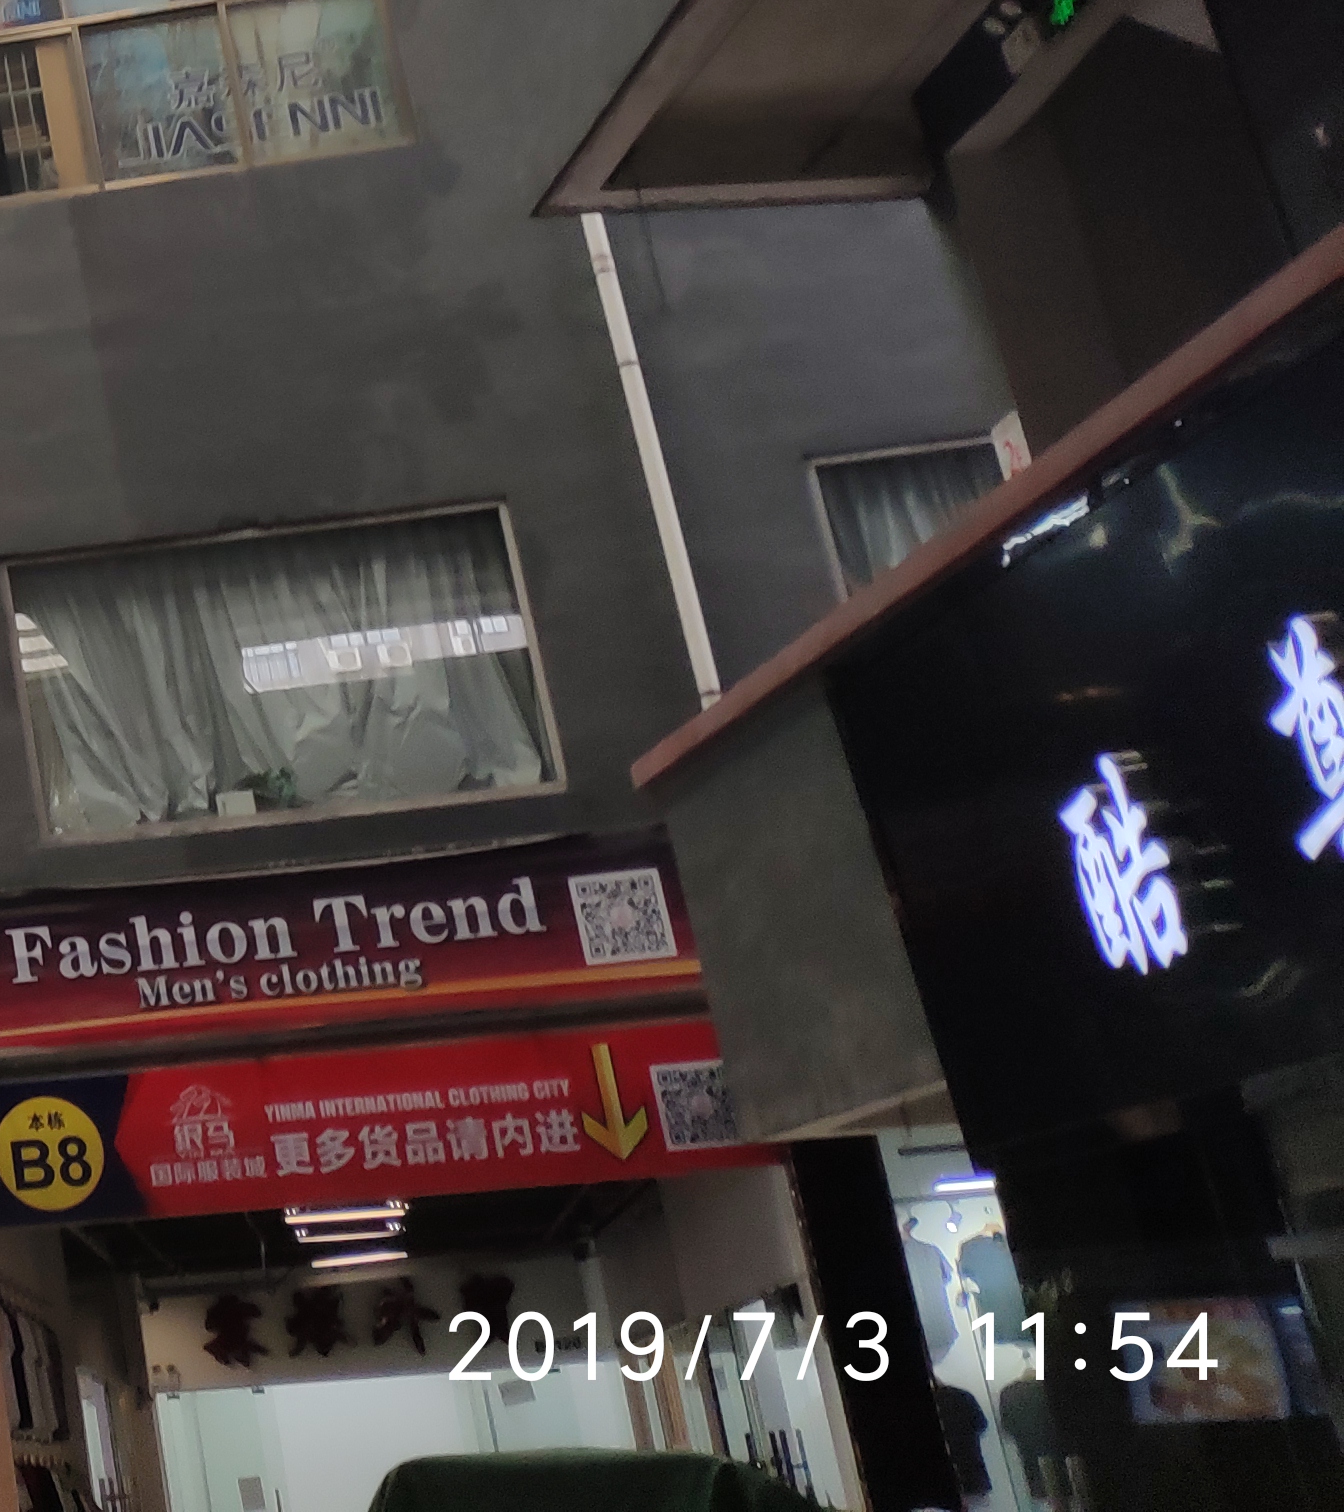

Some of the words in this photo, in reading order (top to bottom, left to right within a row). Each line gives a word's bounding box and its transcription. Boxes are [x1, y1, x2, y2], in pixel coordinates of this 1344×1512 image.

[4, 910, 298, 985] Fashion
[313, 876, 547, 954] Trend
[133, 969, 249, 1009] Men's
[259, 957, 423, 997] clothing
[320, 1090, 444, 1118] INTERNATIONAL
[448, 1082, 528, 1107] CLOTHING
[533, 1078, 569, 1099] CITY
[10, 1135, 92, 1191] B8
[270, 1109, 580, 1176] 更多货品请内进
